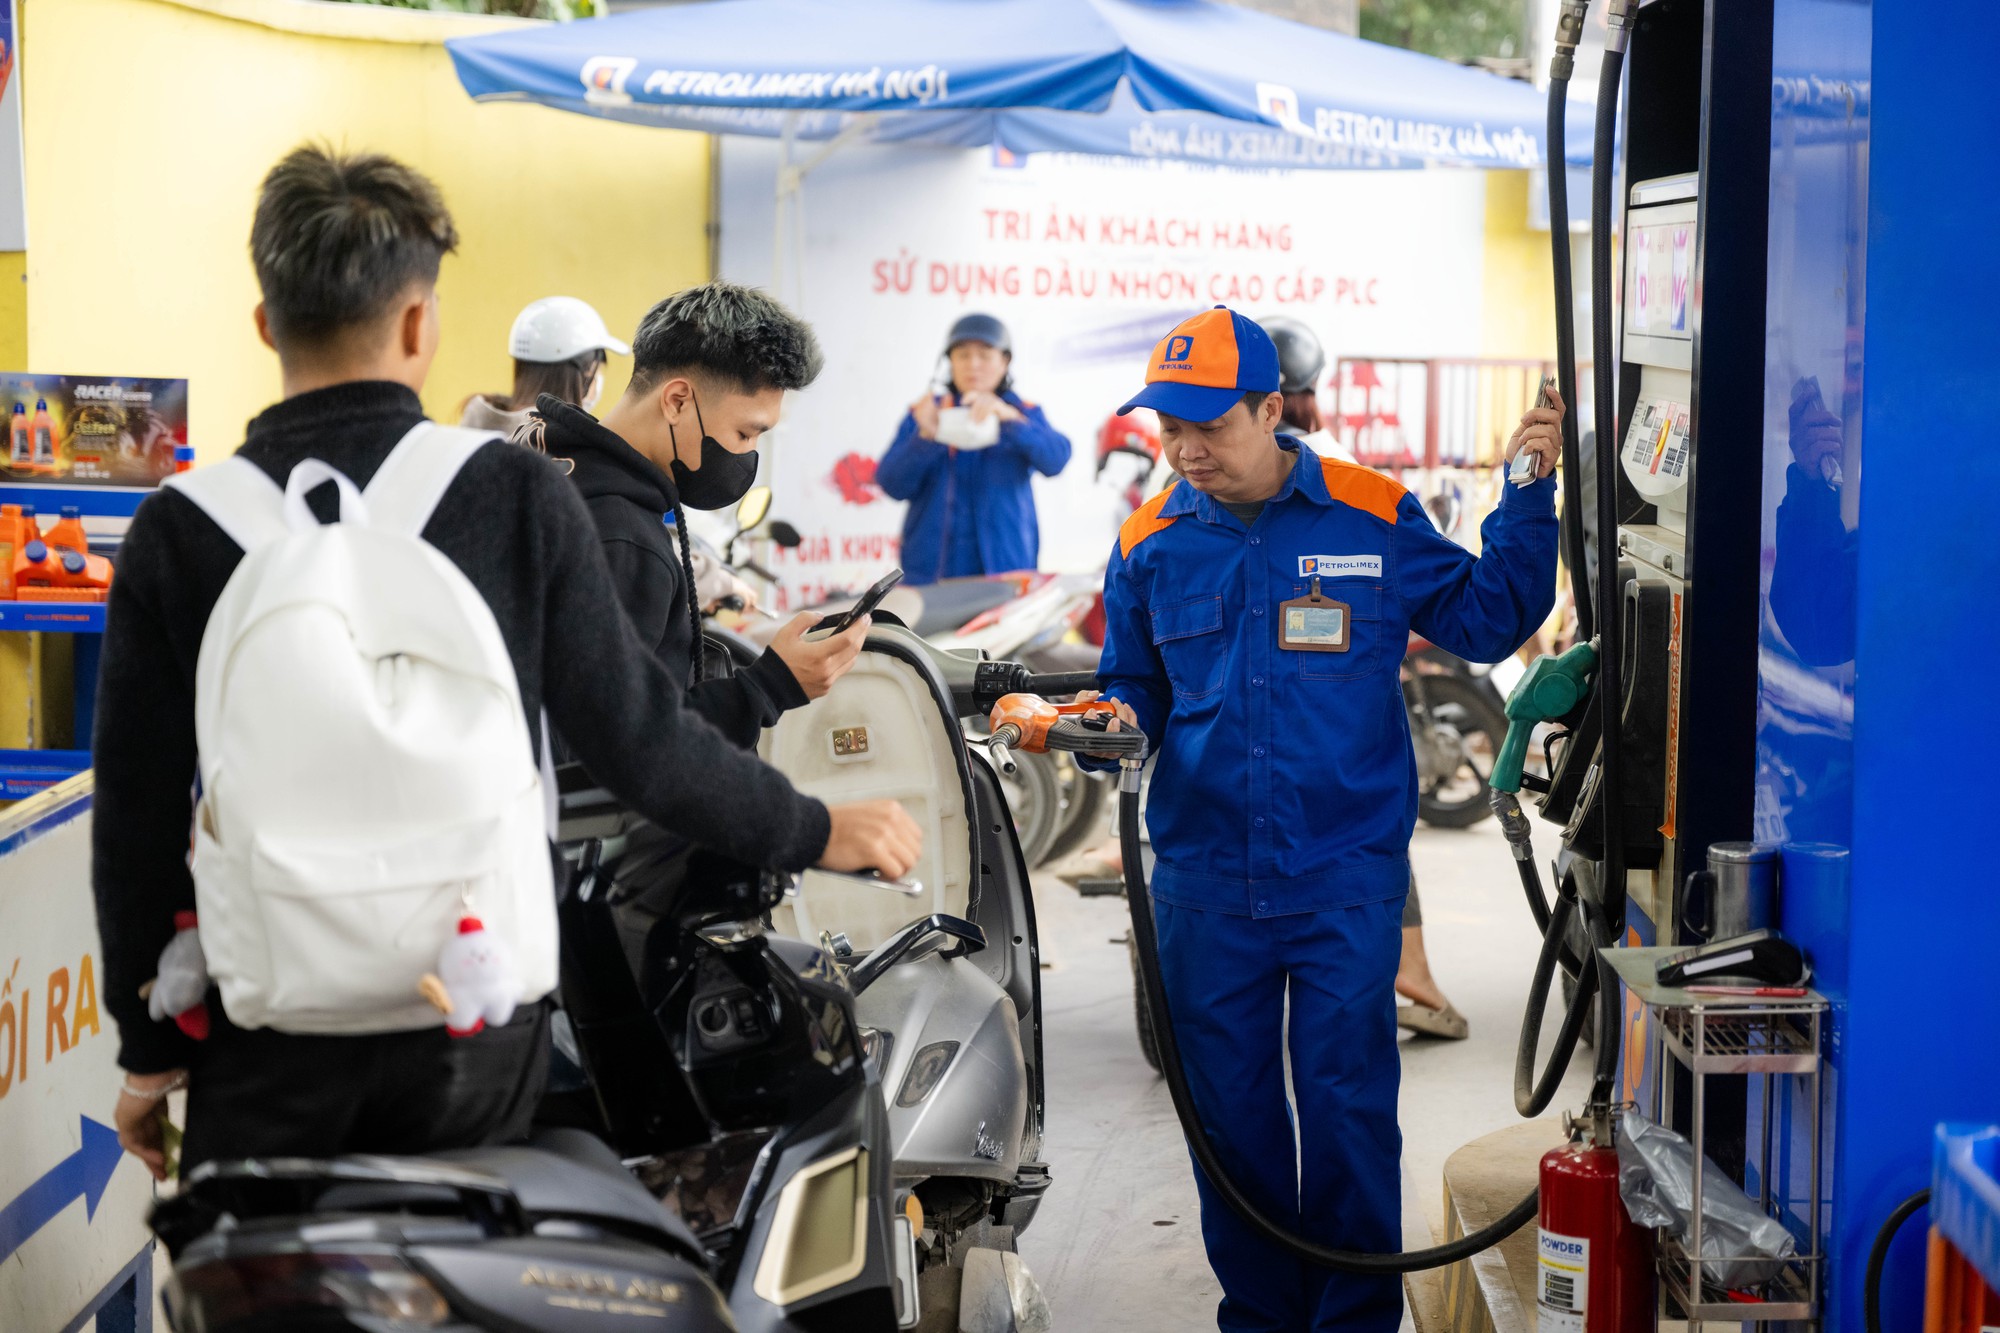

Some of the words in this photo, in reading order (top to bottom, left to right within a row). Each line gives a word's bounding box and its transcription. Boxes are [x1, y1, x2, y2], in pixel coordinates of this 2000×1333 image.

[643, 69, 833, 98] PETROLIMEX
[884, 65, 949, 105] NỘI
[1315, 107, 1454, 156] PETROLIMEX
[982, 209, 1031, 242] TRI
[1098, 210, 1200, 248] KHÁCH
[1212, 214, 1293, 252] HÀNG
[872, 247, 919, 294] SỬ
[928, 262, 1022, 304] DỤNG
[1032, 257, 1098, 299] DẦU
[1207, 272, 1264, 302] CAO
[1274, 264, 1326, 304] CẤP
[1335, 275, 1380, 306] PLC
[1158, 363, 1193, 371] PETROLIMEX
[74, 385, 122, 400] RACER
[1319, 561, 1379, 569] PETROLIMEX
[45, 953, 100, 1064] RA
[1541, 1235, 1583, 1255] POWDER
